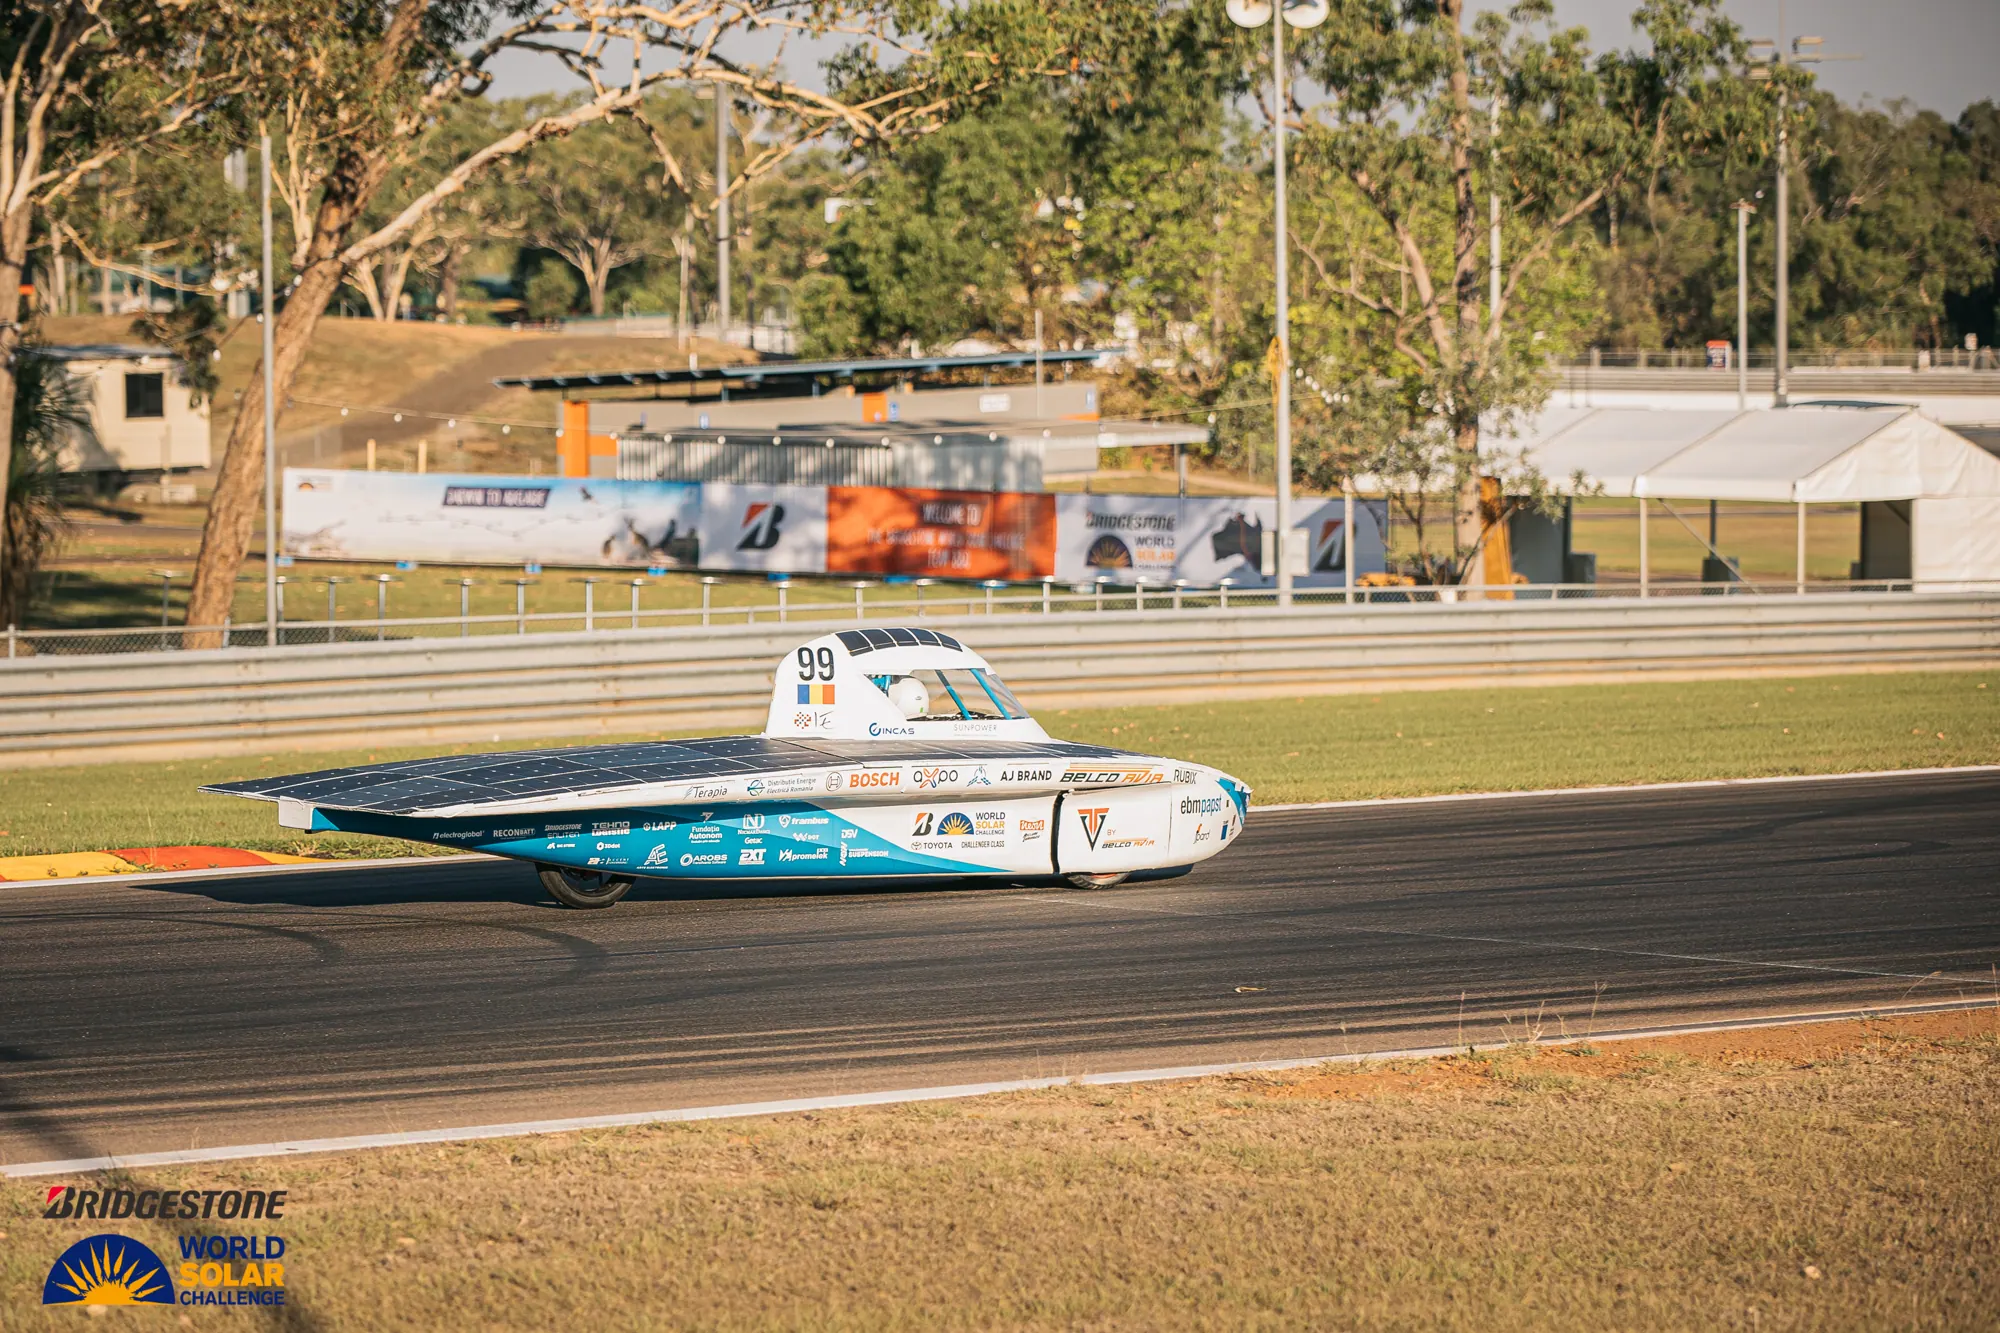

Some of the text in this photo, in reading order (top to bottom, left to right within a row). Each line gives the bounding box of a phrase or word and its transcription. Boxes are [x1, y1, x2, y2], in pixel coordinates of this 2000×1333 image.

[1086, 511, 1176, 532] BRIDGESTONE
[1135, 536, 1175, 548] WORLD
[797, 646, 835, 682] 99
[882, 727, 915, 735] INCAS
[954, 723, 998, 732] SUNPOWER
[850, 772, 900, 787] BOSCH
[1000, 770, 1052, 782] AJ BRAND
[1173, 769, 1197, 785] RUBIX
[693, 786, 728, 798] Terapia
[1181, 795, 1222, 817] ebmpapst
[976, 812, 1006, 820] WORLD
[652, 821, 677, 831] LAPP
[976, 821, 1005, 829] SOLAR
[689, 832, 723, 841] Autonom
[1106, 828, 1117, 836] BY
[923, 842, 953, 850] TOYOTA
[961, 840, 1005, 849] CHALLENGER CLASS
[692, 854, 728, 862] AROBS
